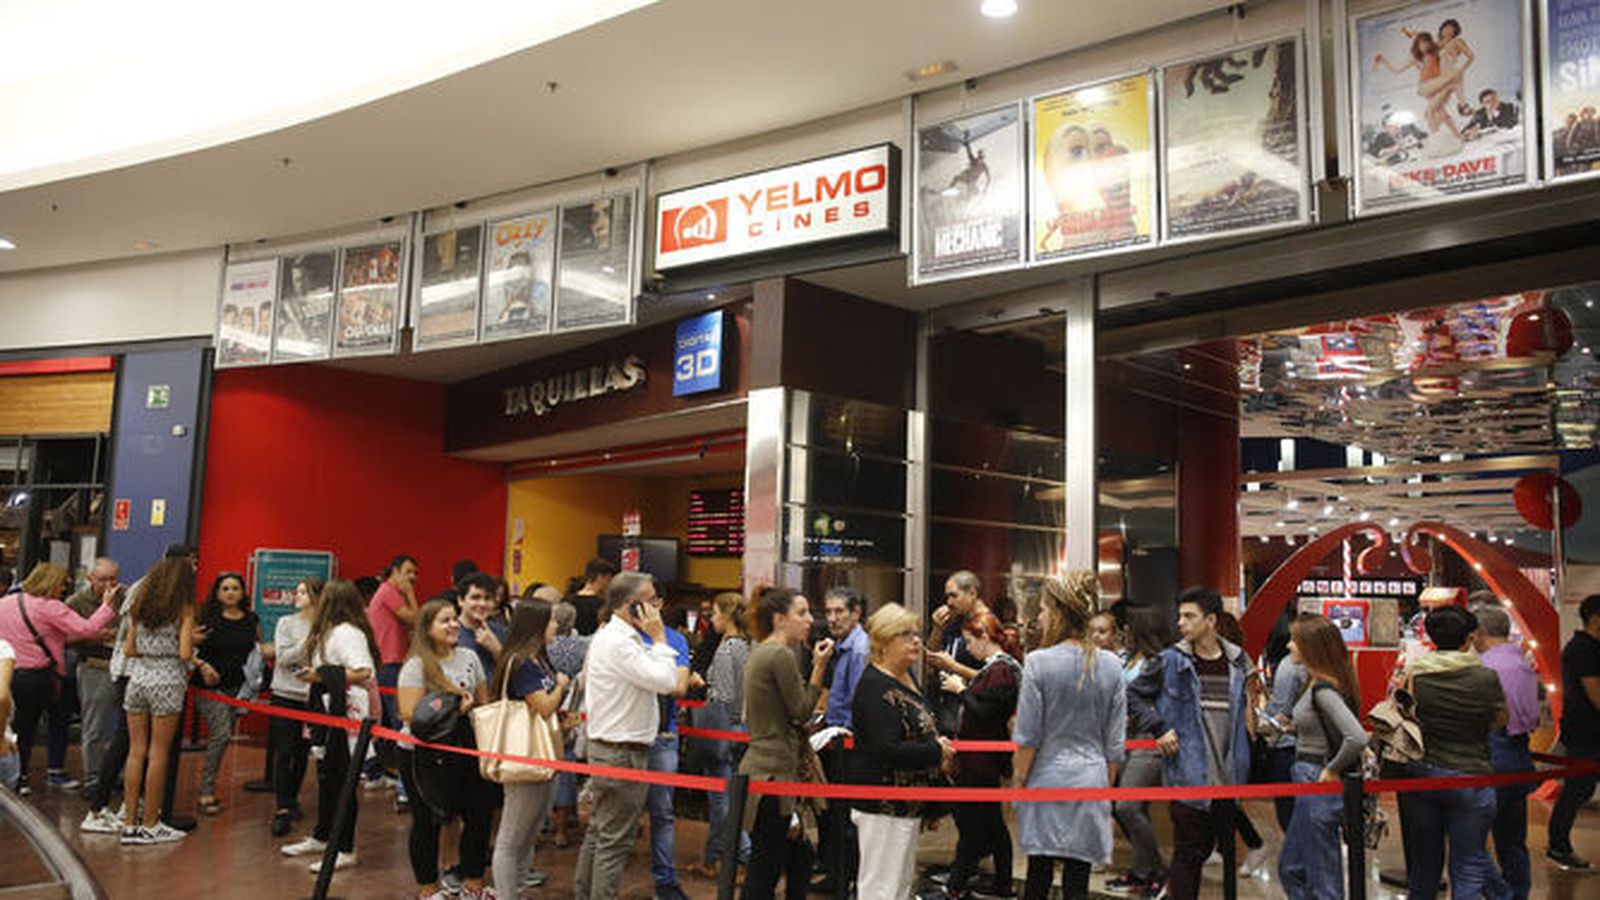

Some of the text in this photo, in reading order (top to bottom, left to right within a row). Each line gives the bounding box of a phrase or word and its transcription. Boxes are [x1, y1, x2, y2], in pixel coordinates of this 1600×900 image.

[1442, 156, 1497, 178] DAVE
[738, 163, 887, 215] YELMO
[748, 201, 870, 238] CINES
[676, 348, 718, 382] 3D
[503, 355, 648, 416] TAQUILLAS
